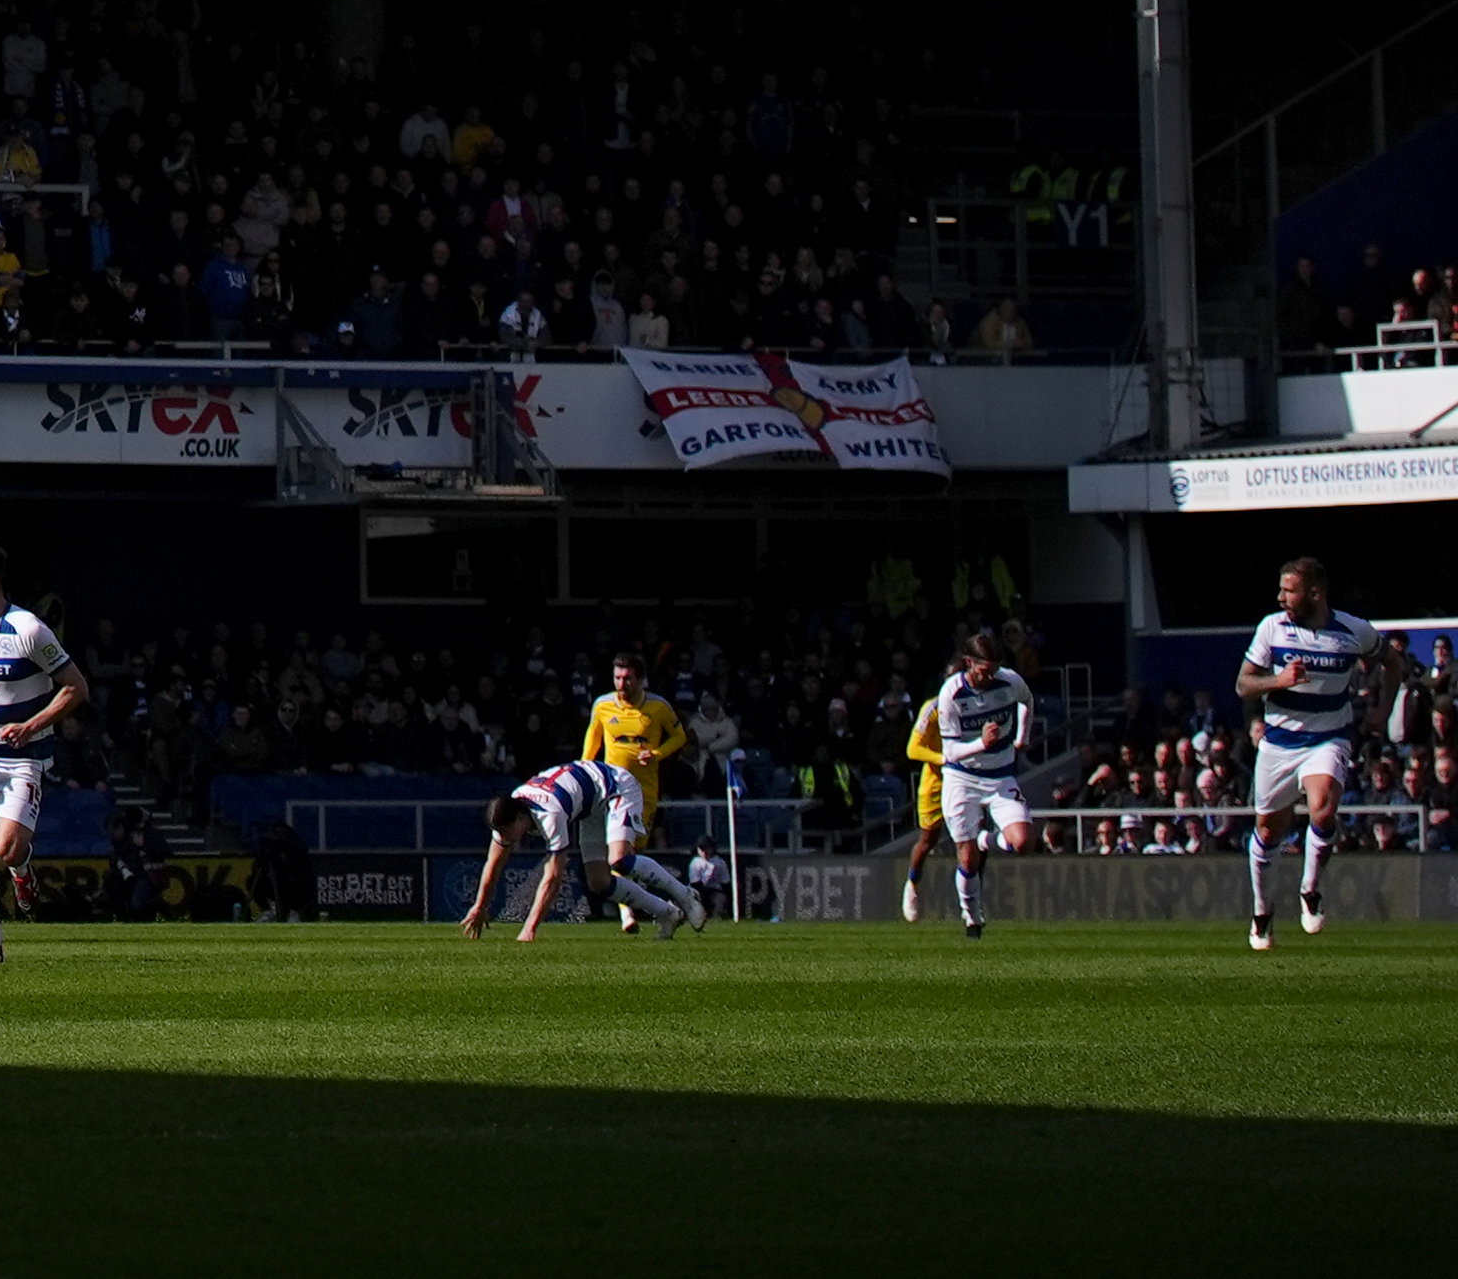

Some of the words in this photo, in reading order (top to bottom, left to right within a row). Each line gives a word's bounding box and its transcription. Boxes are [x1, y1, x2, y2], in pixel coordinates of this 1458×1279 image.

[1057, 203, 1111, 248] Y1
[178, 438, 241, 459] .CO.UK
[1245, 467, 1298, 487] LOFTUS
[1301, 461, 1397, 484] ENGINEERING
